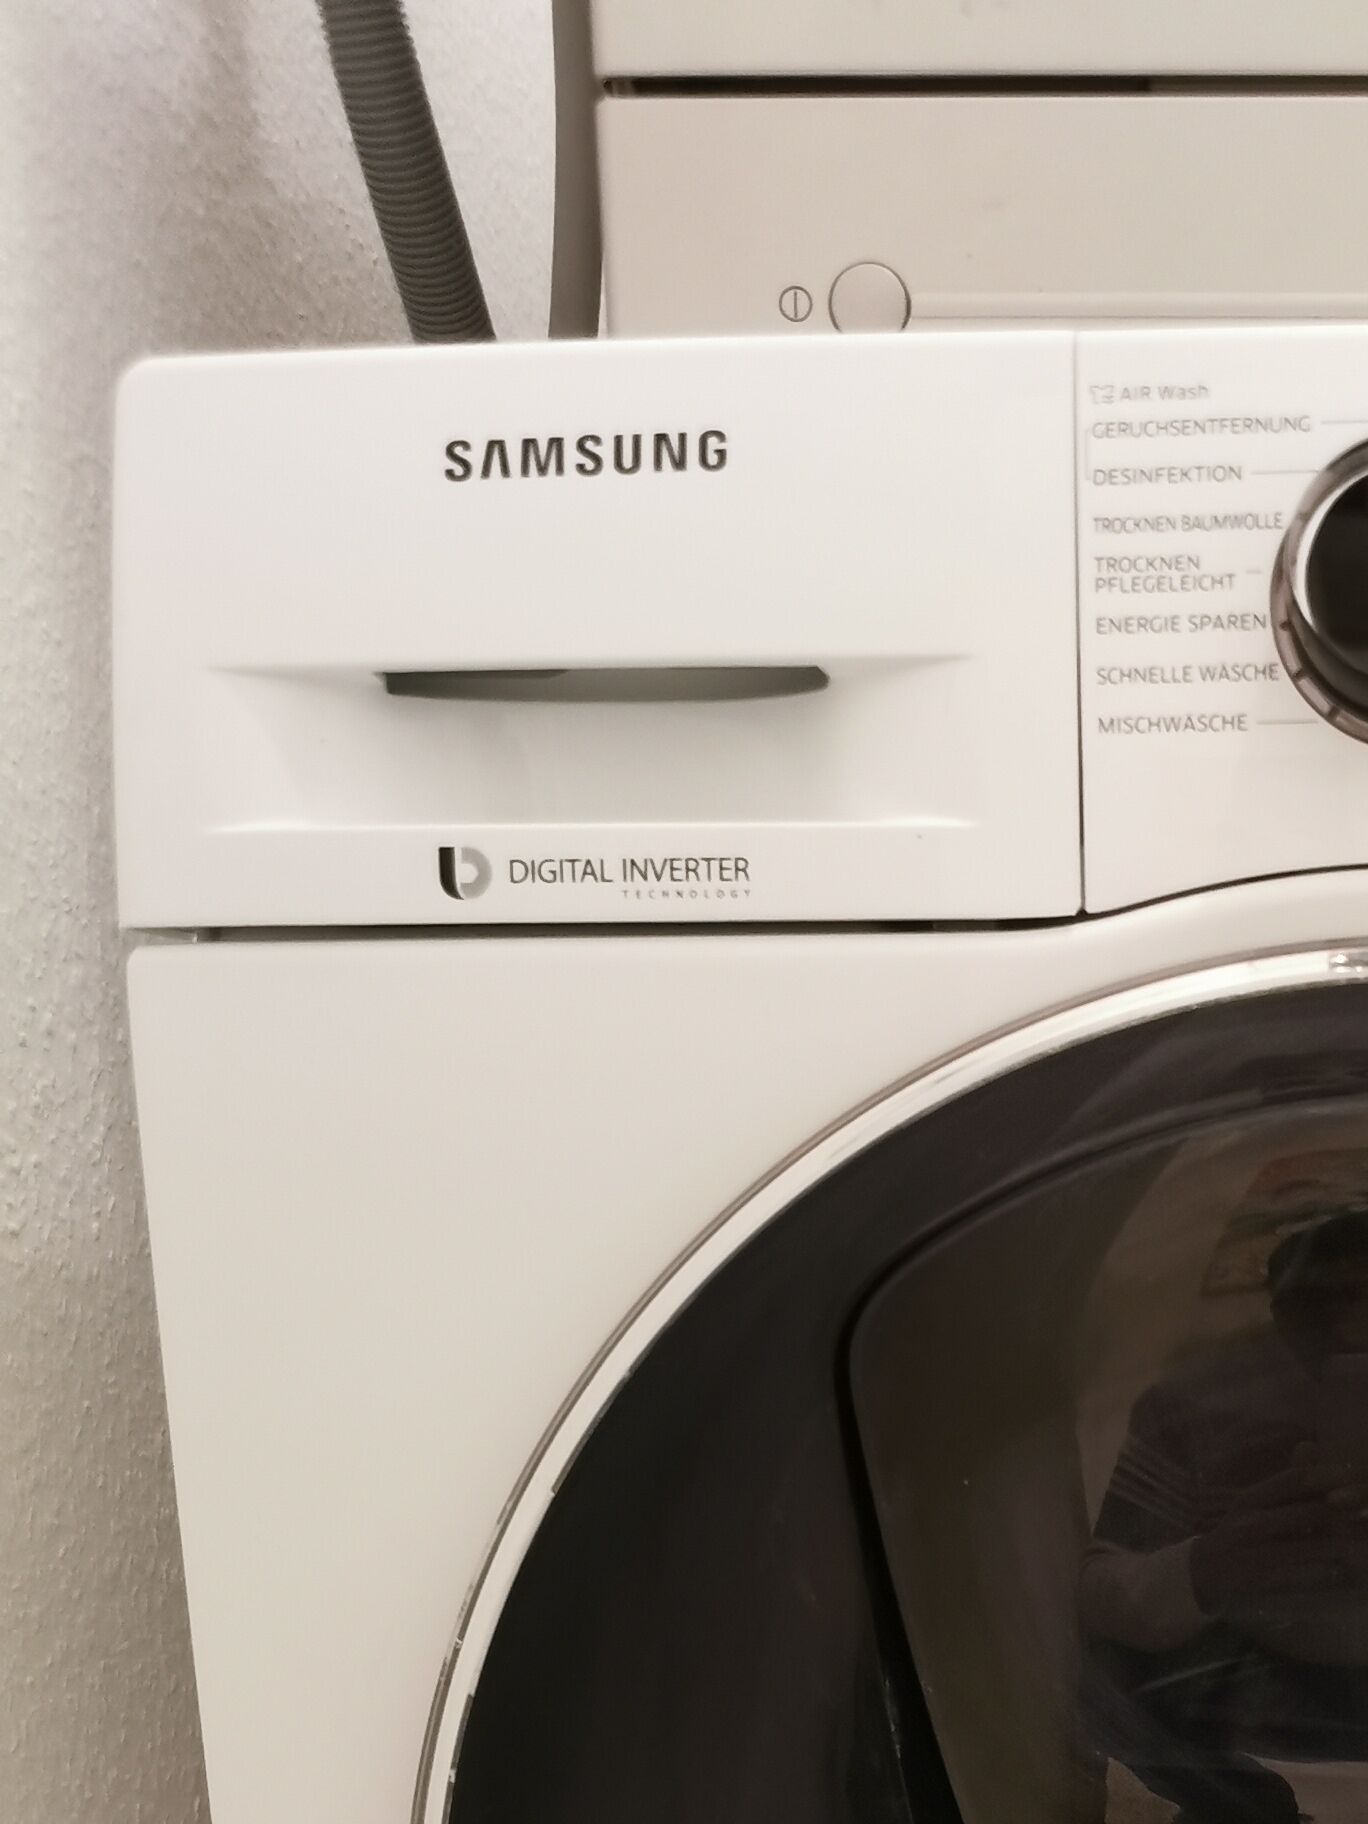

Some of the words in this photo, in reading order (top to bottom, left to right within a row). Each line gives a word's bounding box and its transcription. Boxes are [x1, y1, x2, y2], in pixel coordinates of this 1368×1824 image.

[1119, 385, 1152, 401] AIR
[1158, 384, 1210, 400] Wash
[1091, 415, 1311, 440] GERUCHSENTFERNUNG
[444, 429, 728, 482] SAMSUNG
[1092, 464, 1243, 486] DESINFEKTION
[1093, 516, 1177, 535] TROCKNEN
[1181, 512, 1284, 532] BAUMWOLLE
[1094, 554, 1201, 575] TROCKNEN
[1095, 573, 1236, 594] PFLEGELEICHT
[1096, 615, 1181, 635] ENERGIE
[1187, 612, 1268, 633] SPAREN
[1096, 665, 1193, 685] SCHNELLE
[508, 859, 614, 885] DIGITAL
[621, 856, 751, 883] INVERTER
[621, 888, 751, 900] TECHNOLOGY
